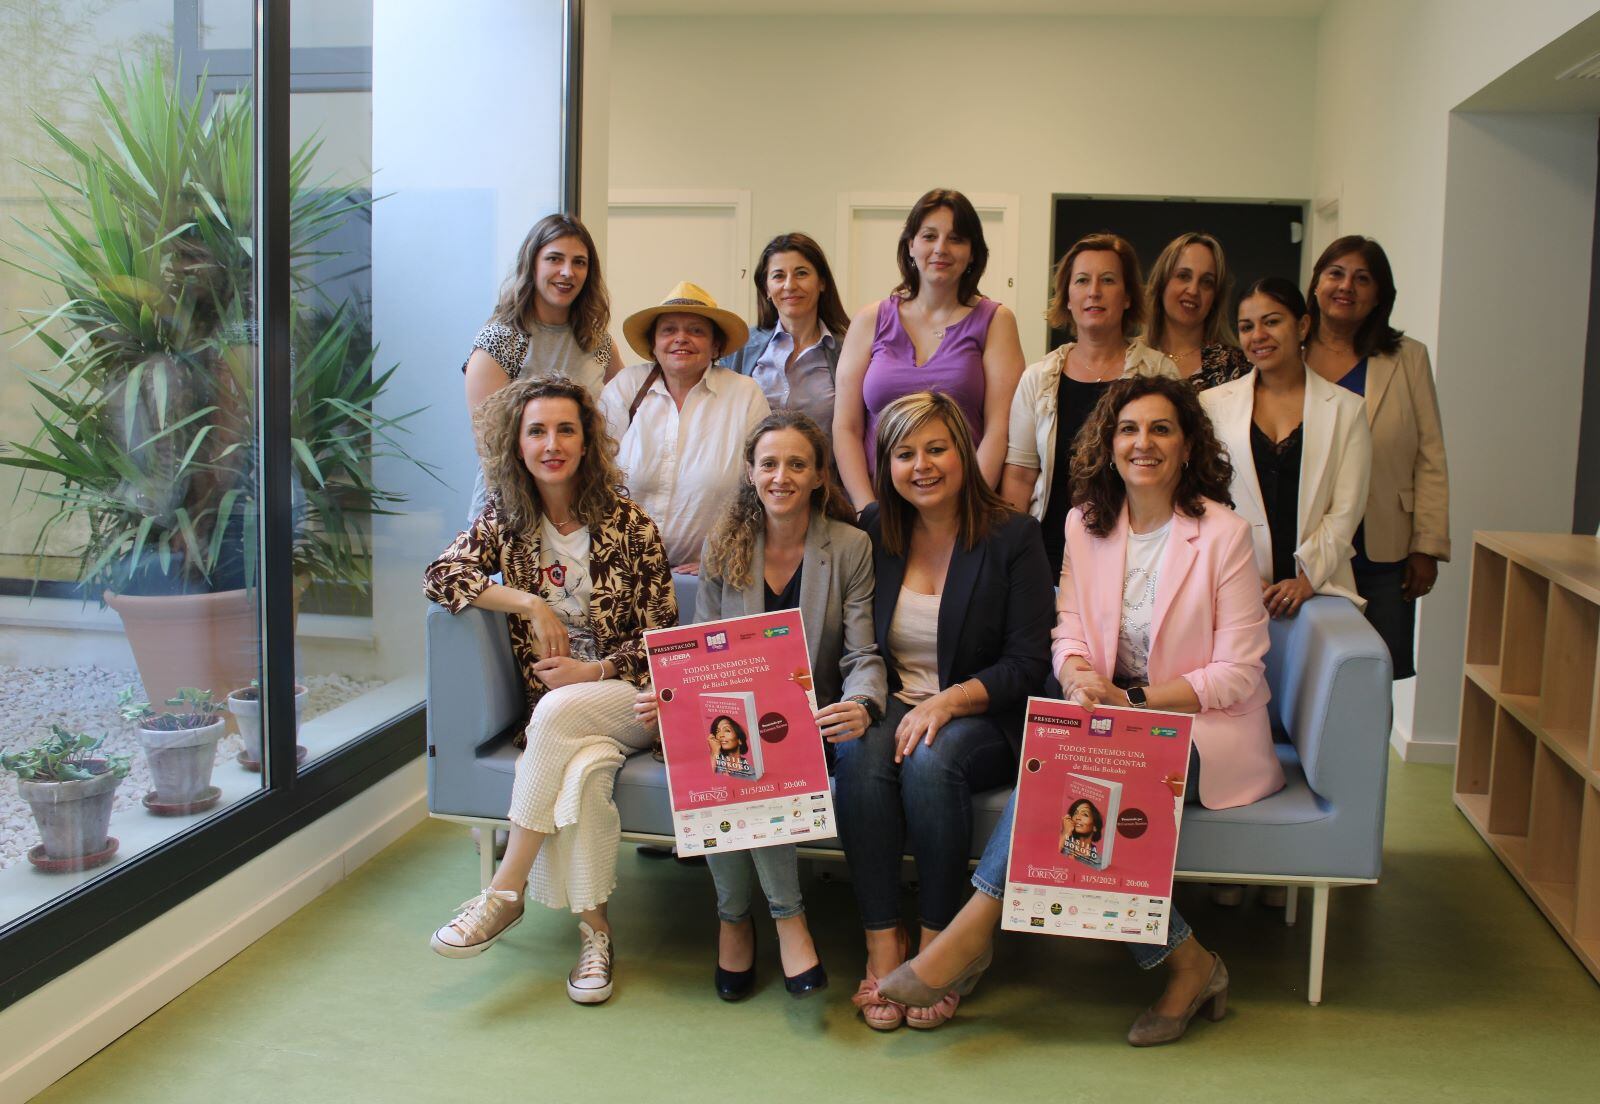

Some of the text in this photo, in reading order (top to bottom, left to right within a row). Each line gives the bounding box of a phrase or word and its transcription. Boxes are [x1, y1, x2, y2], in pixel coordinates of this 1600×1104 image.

[740, 268, 746, 280] 7
[1008, 277, 1014, 288] 6
[683, 656, 766, 675] TODOS TENEMOS UNA
[682, 664, 770, 684] HISTORIA QUE CONTAR
[702, 681, 710, 689] de
[1047, 727, 1070, 736] LIDERA
[1058, 744, 1086, 753] TODOS
[1088, 747, 1126, 757] TENEMOS
[716, 760, 750, 771] BOKOKO
[1054, 753, 1092, 762] HISTORIA
[1113, 759, 1147, 768] CONTAR
[690, 790, 728, 803] LORENZO
[740, 784, 775, 796] 31/5/2023
[784, 780, 807, 789] 20:00h
[1064, 840, 1097, 858] BOKOKO
[1065, 834, 1097, 852] BISILA
[1028, 869, 1149, 888] LORENZO 31/5/2023 20:00h
